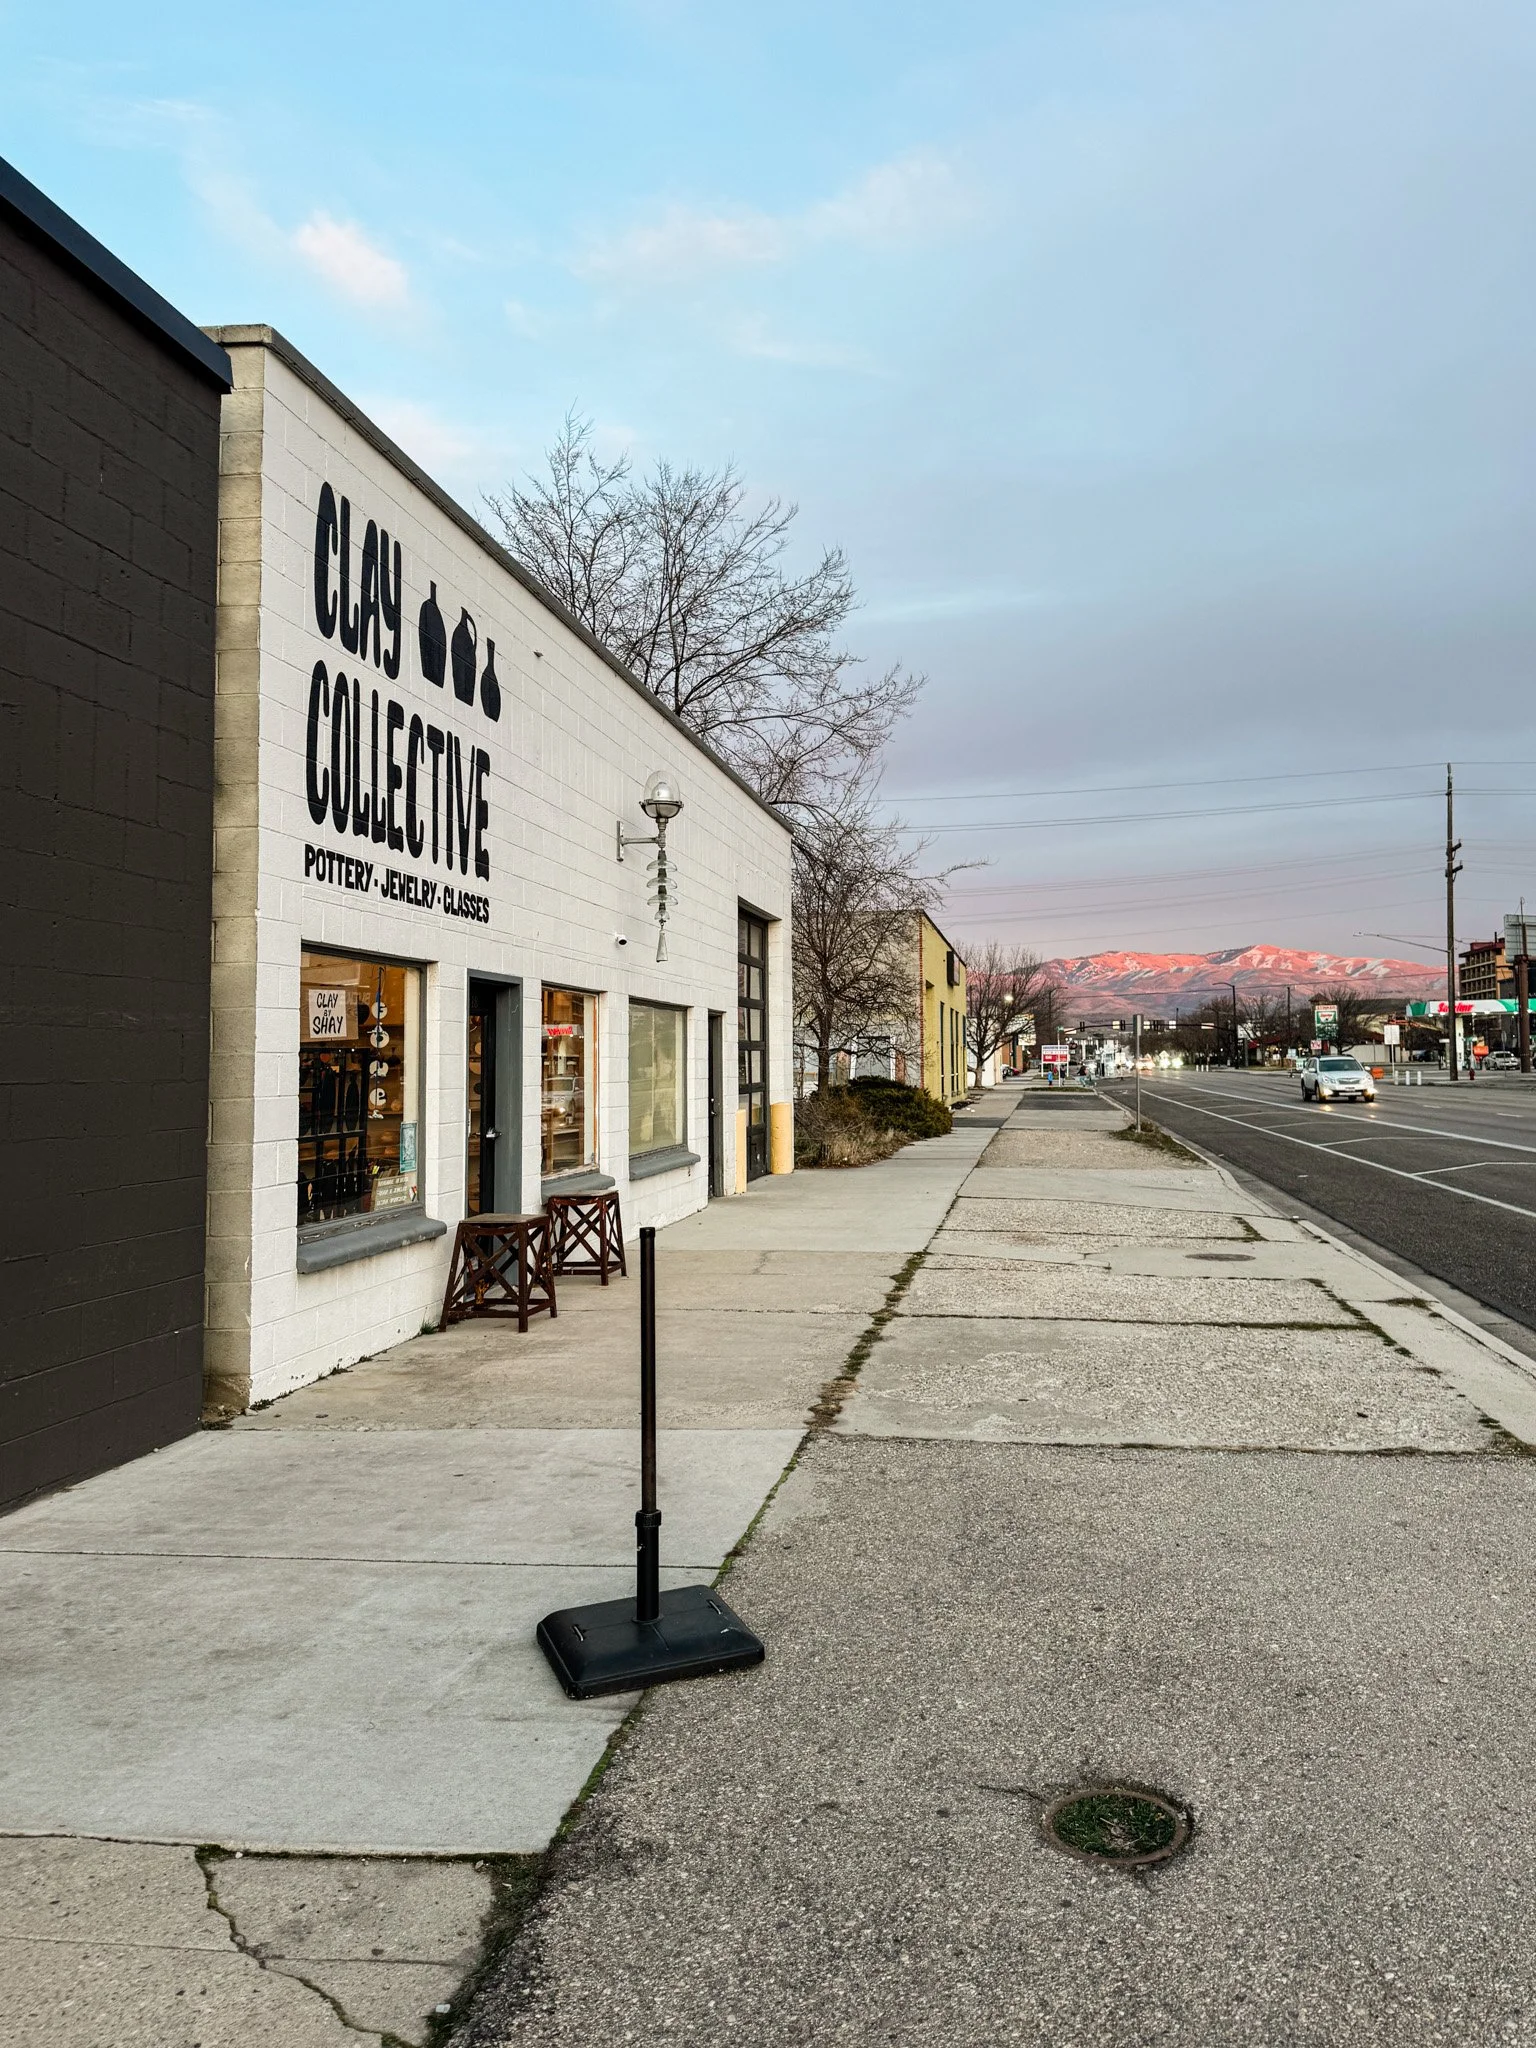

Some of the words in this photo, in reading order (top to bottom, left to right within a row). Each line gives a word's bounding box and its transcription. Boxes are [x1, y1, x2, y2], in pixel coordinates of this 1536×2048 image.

[314, 481, 402, 680] CLAY
[305, 660, 490, 882] COLLECTIVE
[304, 843, 373, 892] POTTERY
[381, 868, 435, 909] JEWELRY
[443, 888, 490, 924] CLASSES
[312, 1016, 343, 1034] SHAY
[316, 992, 338, 1008] CLAY
